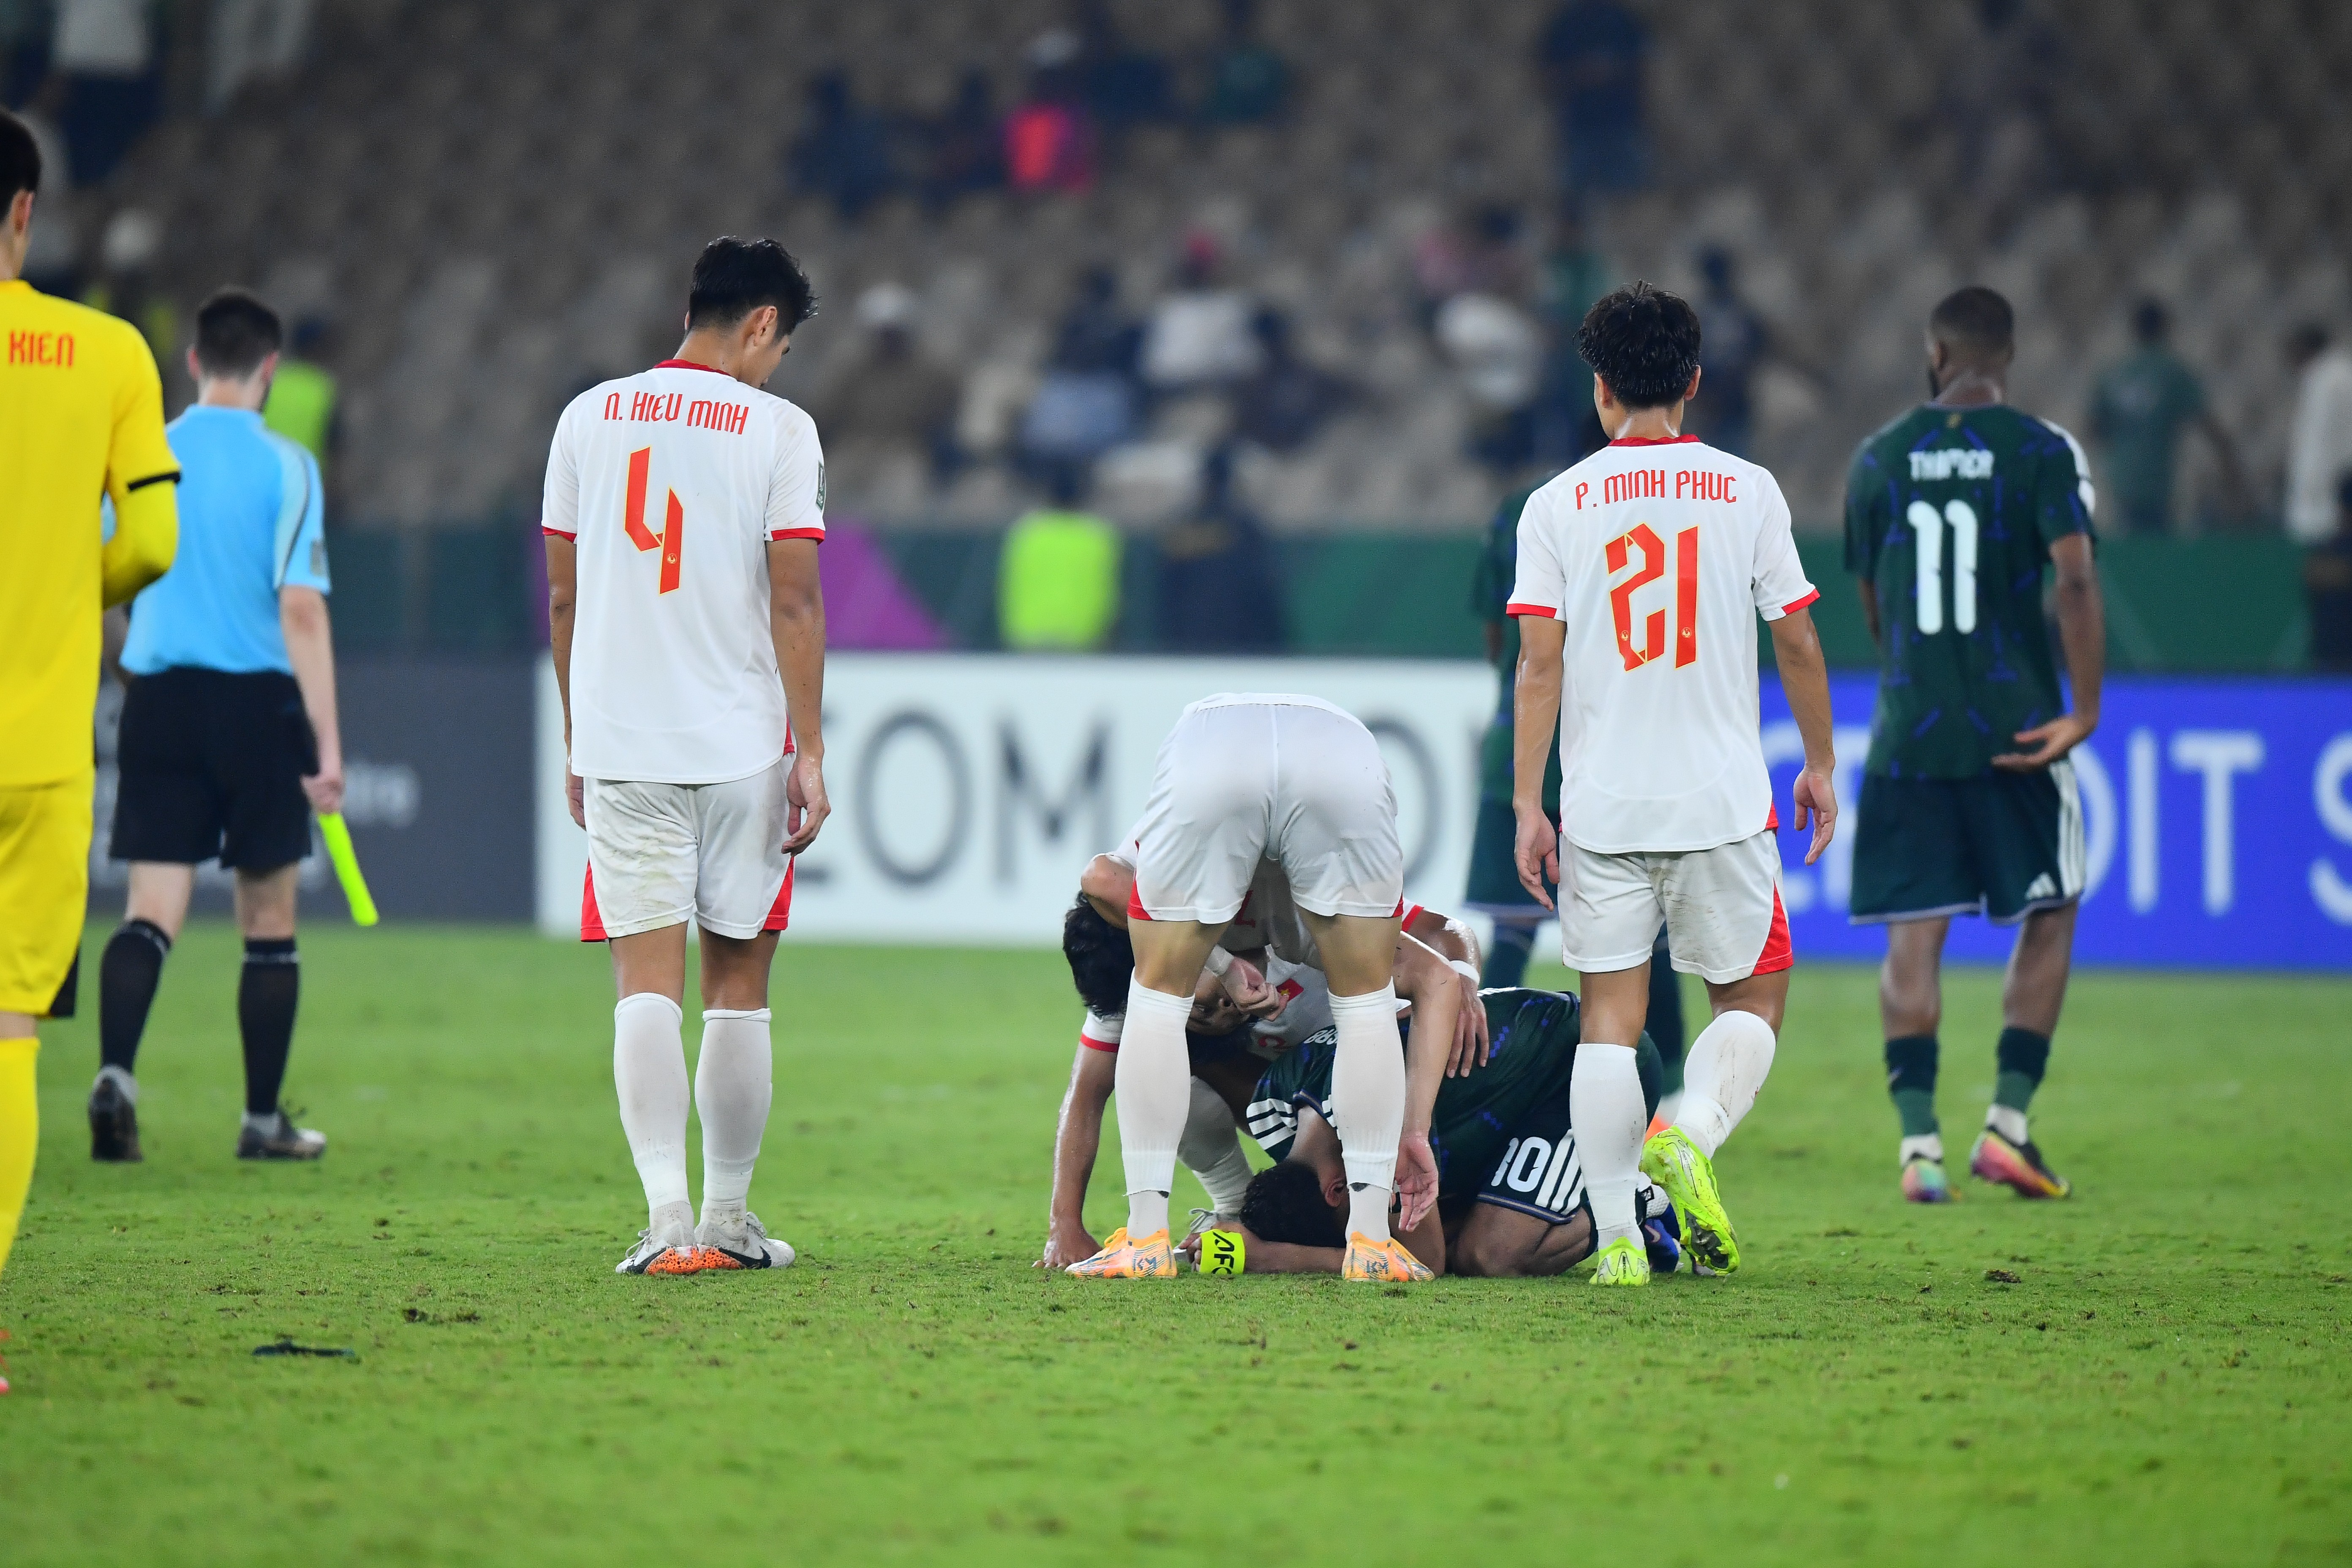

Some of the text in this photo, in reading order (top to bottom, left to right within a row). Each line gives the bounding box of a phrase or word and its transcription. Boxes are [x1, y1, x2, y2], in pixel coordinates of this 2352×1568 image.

[9, 331, 74, 368] KIEN
[604, 391, 749, 435] N. HIEU MINH
[1575, 469, 1737, 510] P. MINH PHUC
[624, 446, 683, 595] 4
[1907, 499, 1977, 634] 11
[1605, 523, 1698, 672] 21
[1491, 1137, 1552, 1192] 10
